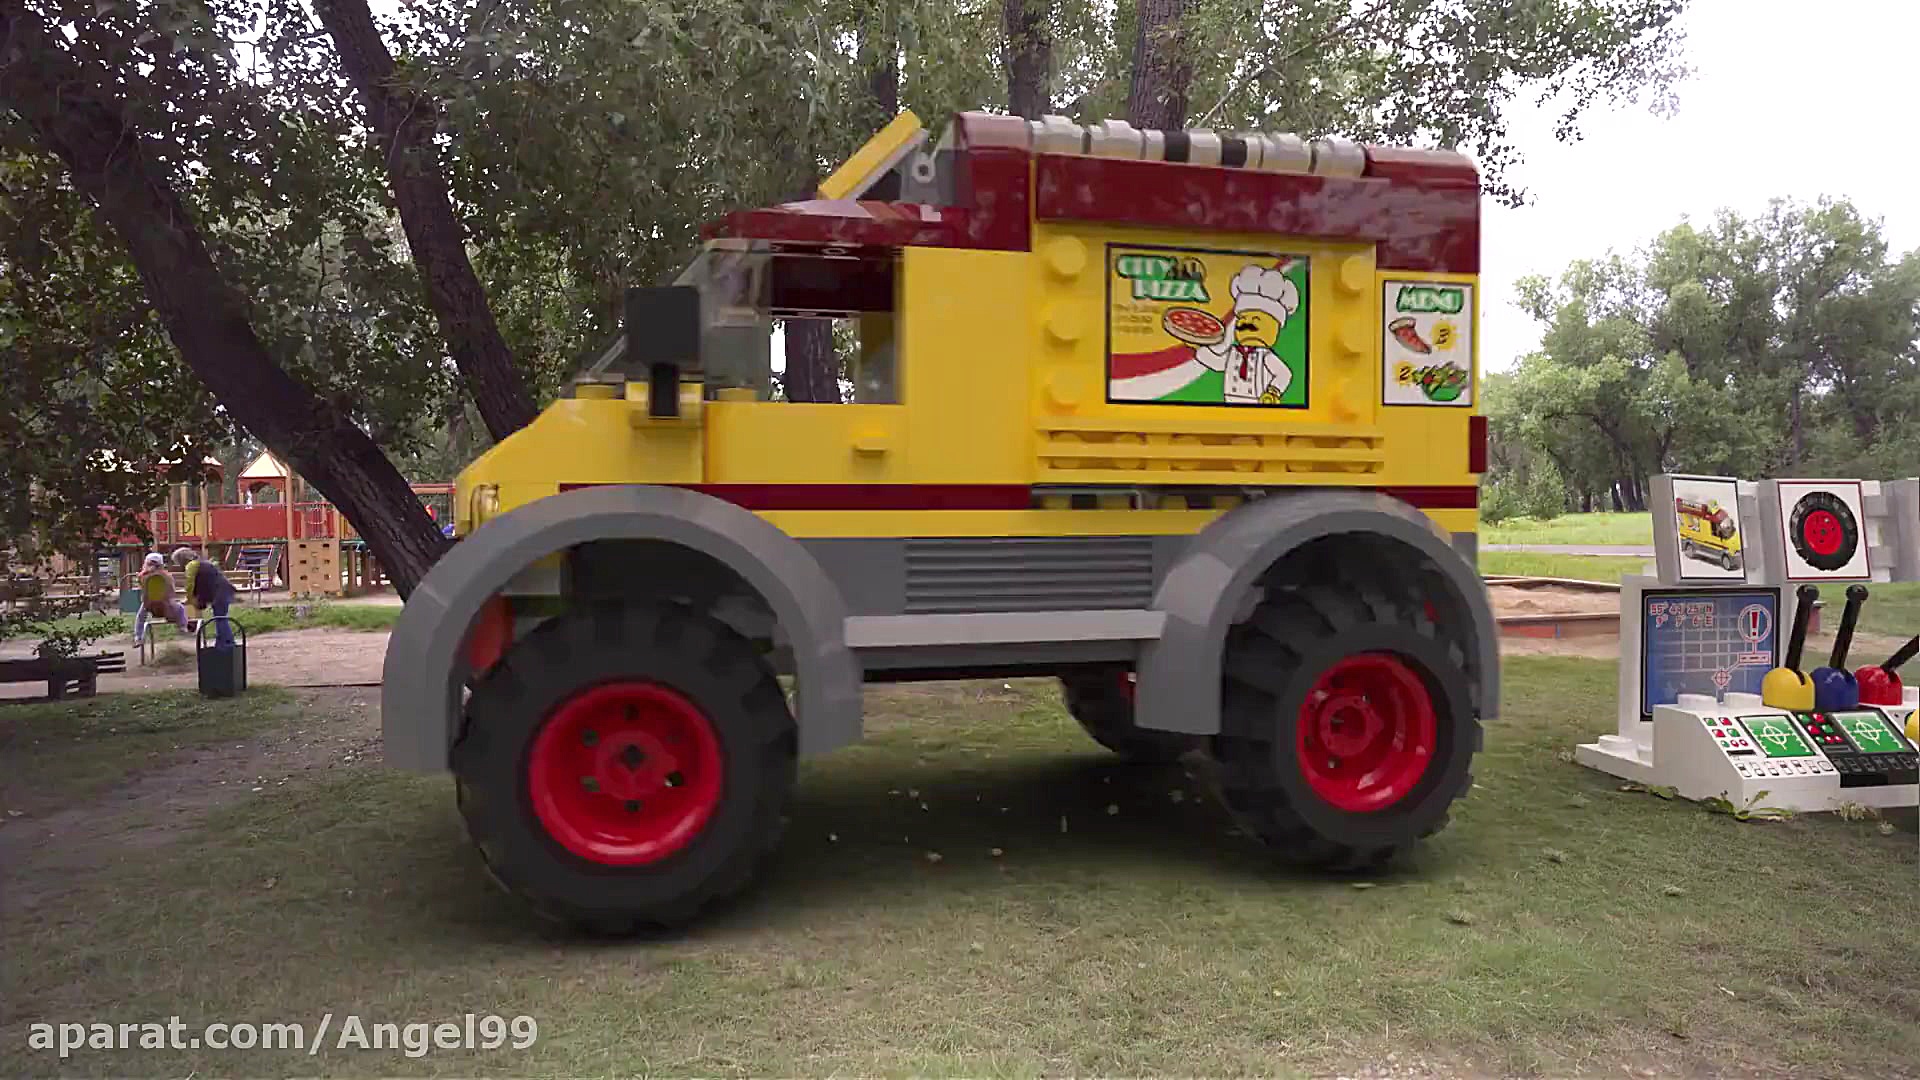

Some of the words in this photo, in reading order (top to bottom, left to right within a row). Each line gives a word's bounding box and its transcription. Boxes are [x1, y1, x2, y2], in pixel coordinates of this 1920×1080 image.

[1117, 255, 1177, 280] CITY
[1133, 279, 1210, 303] PIZZA
[1397, 287, 1464, 313] MENU
